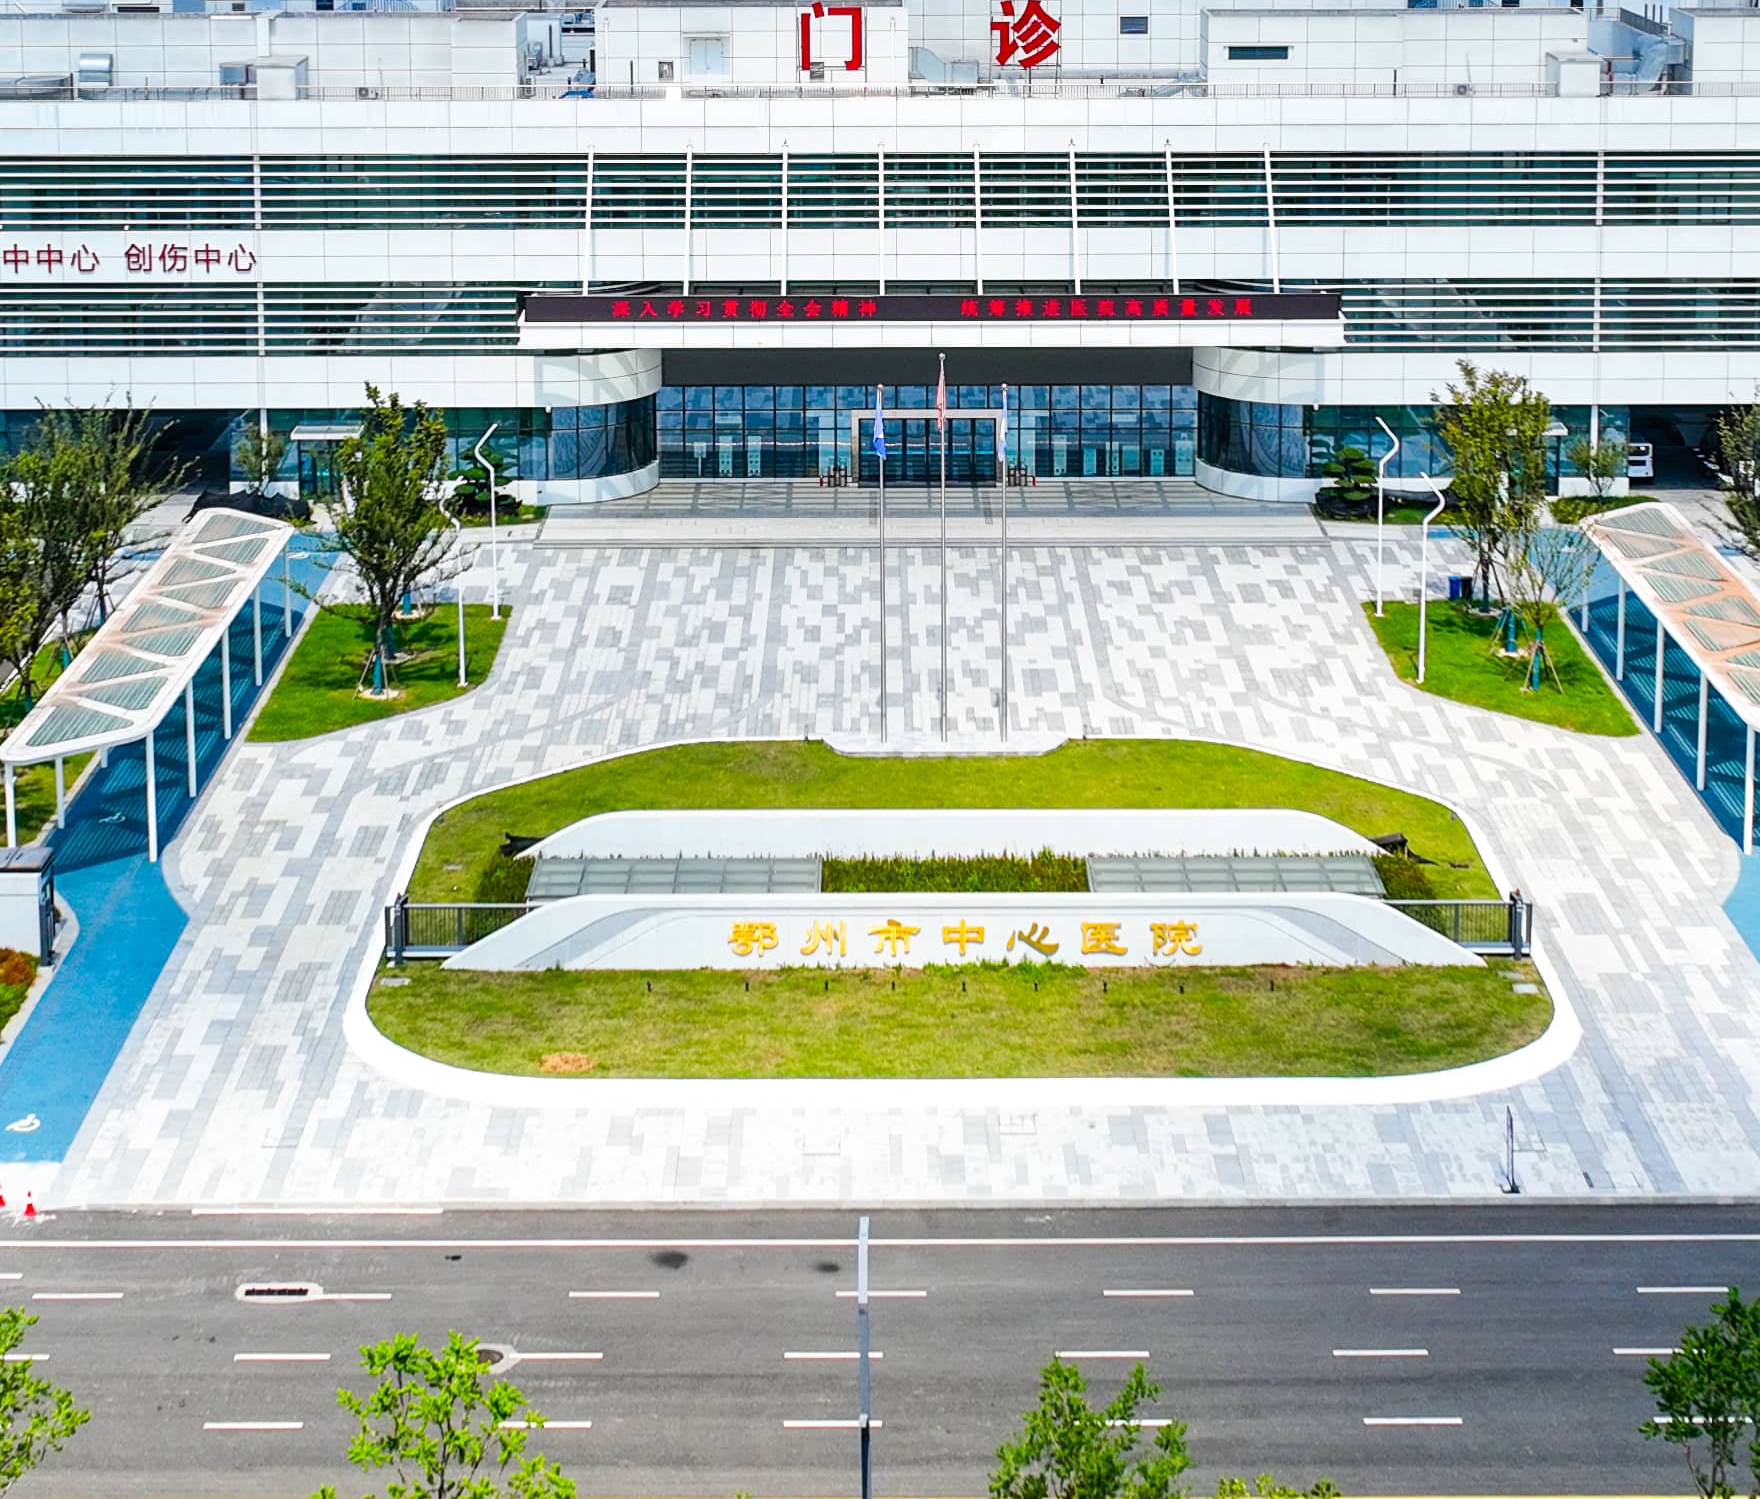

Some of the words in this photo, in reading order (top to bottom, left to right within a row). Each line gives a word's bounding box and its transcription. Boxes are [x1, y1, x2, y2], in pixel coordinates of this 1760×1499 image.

[800, 1, 1062, 71] 门诊
[124, 244, 256, 274] 创伤中心
[611, 299, 878, 319] 深入学习贯彻全会精神
[727, 919, 1203, 957] 鄂州市中心医院
